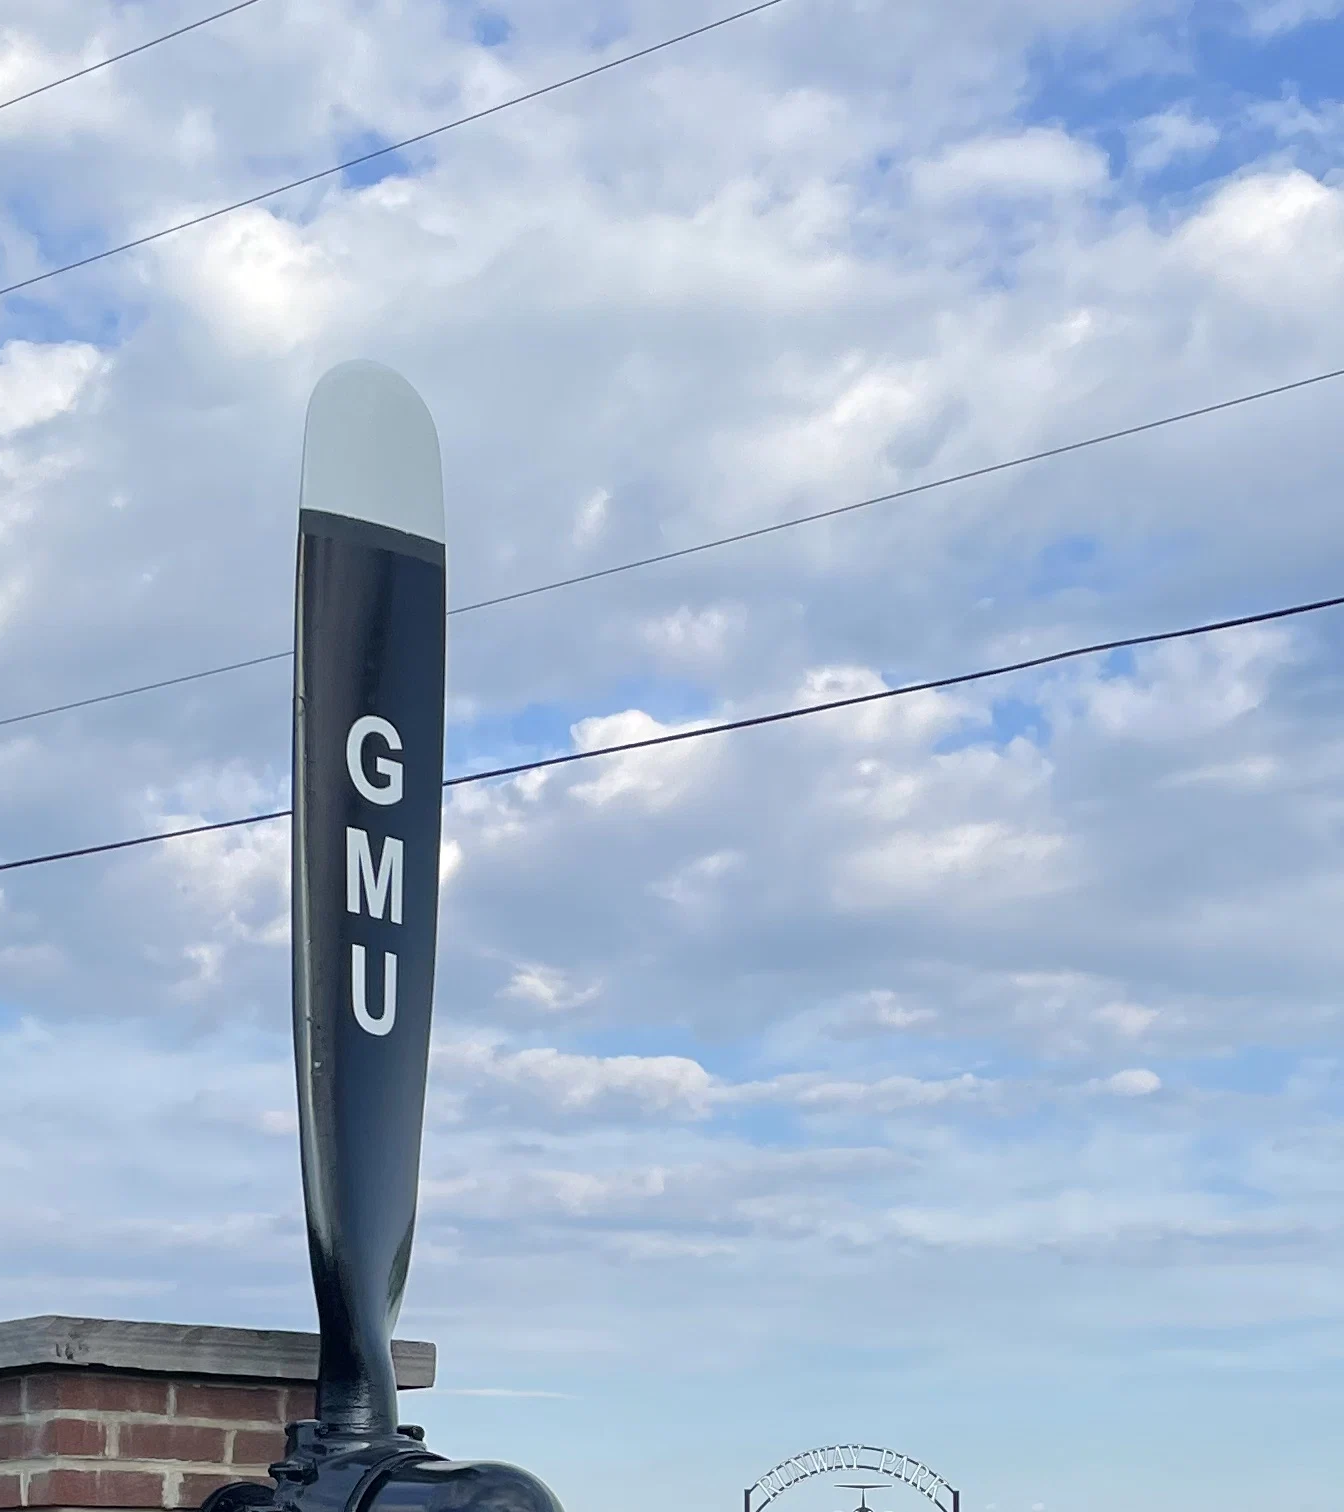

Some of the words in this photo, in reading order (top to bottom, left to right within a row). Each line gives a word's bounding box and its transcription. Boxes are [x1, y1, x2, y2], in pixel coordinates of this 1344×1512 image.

[345, 715, 404, 1036] GMU
[757, 1444, 864, 1502] RUNWAY
[877, 1447, 949, 1503] PARK
